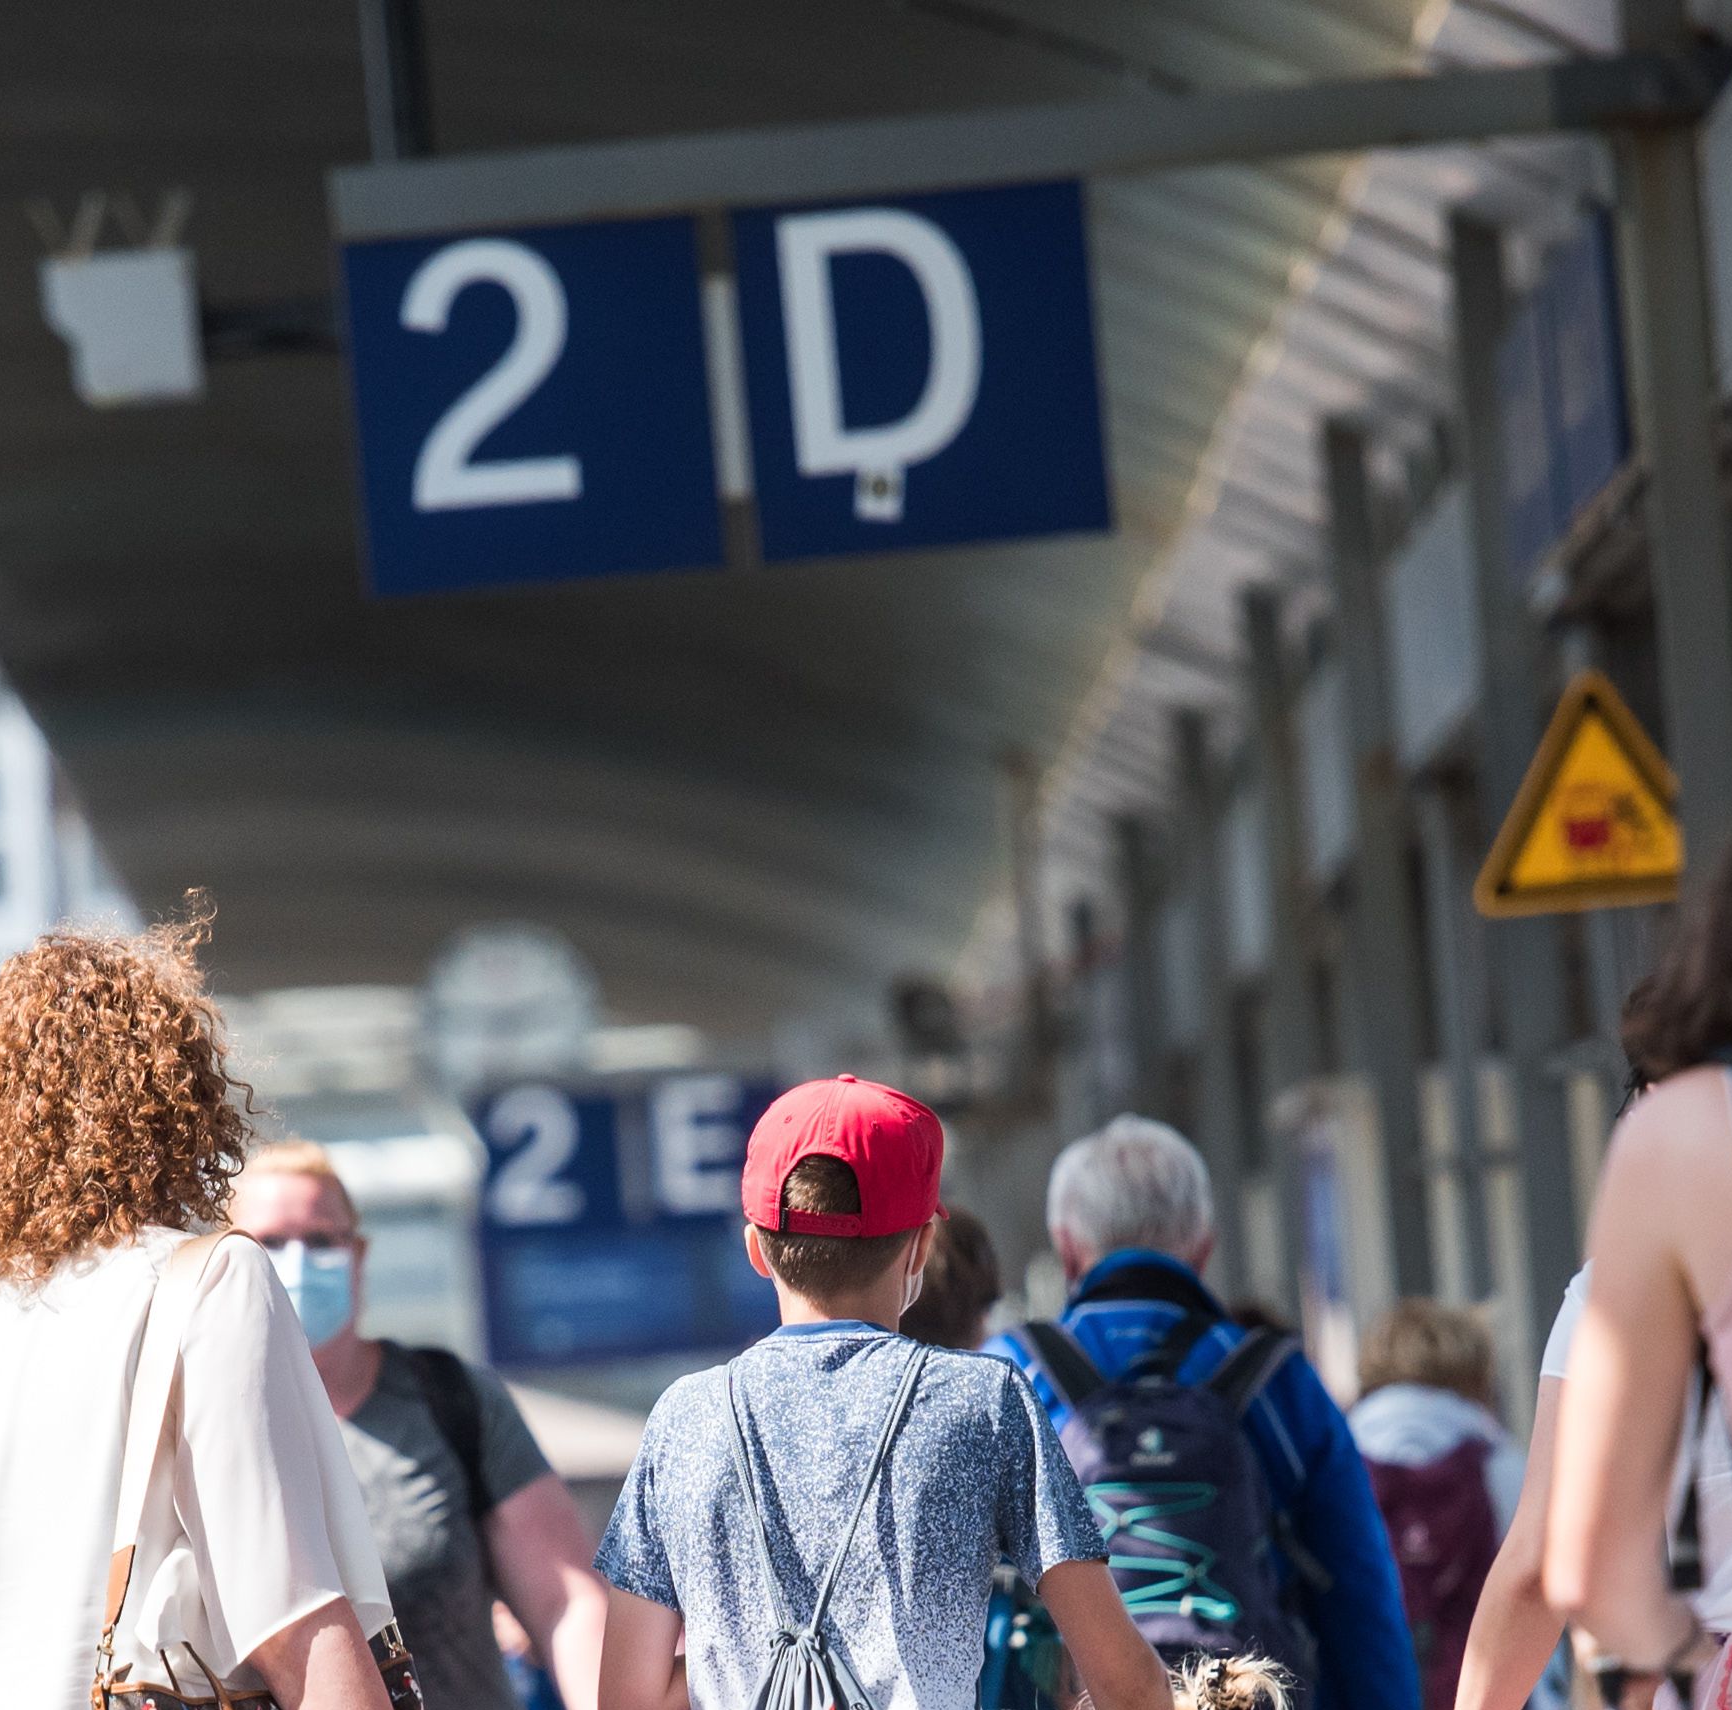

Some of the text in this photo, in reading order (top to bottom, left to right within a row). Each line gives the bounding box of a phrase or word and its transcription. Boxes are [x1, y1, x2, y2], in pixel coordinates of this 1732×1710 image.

[400, 207, 983, 513] 2 D
[485, 1074, 743, 1227] 2 E
